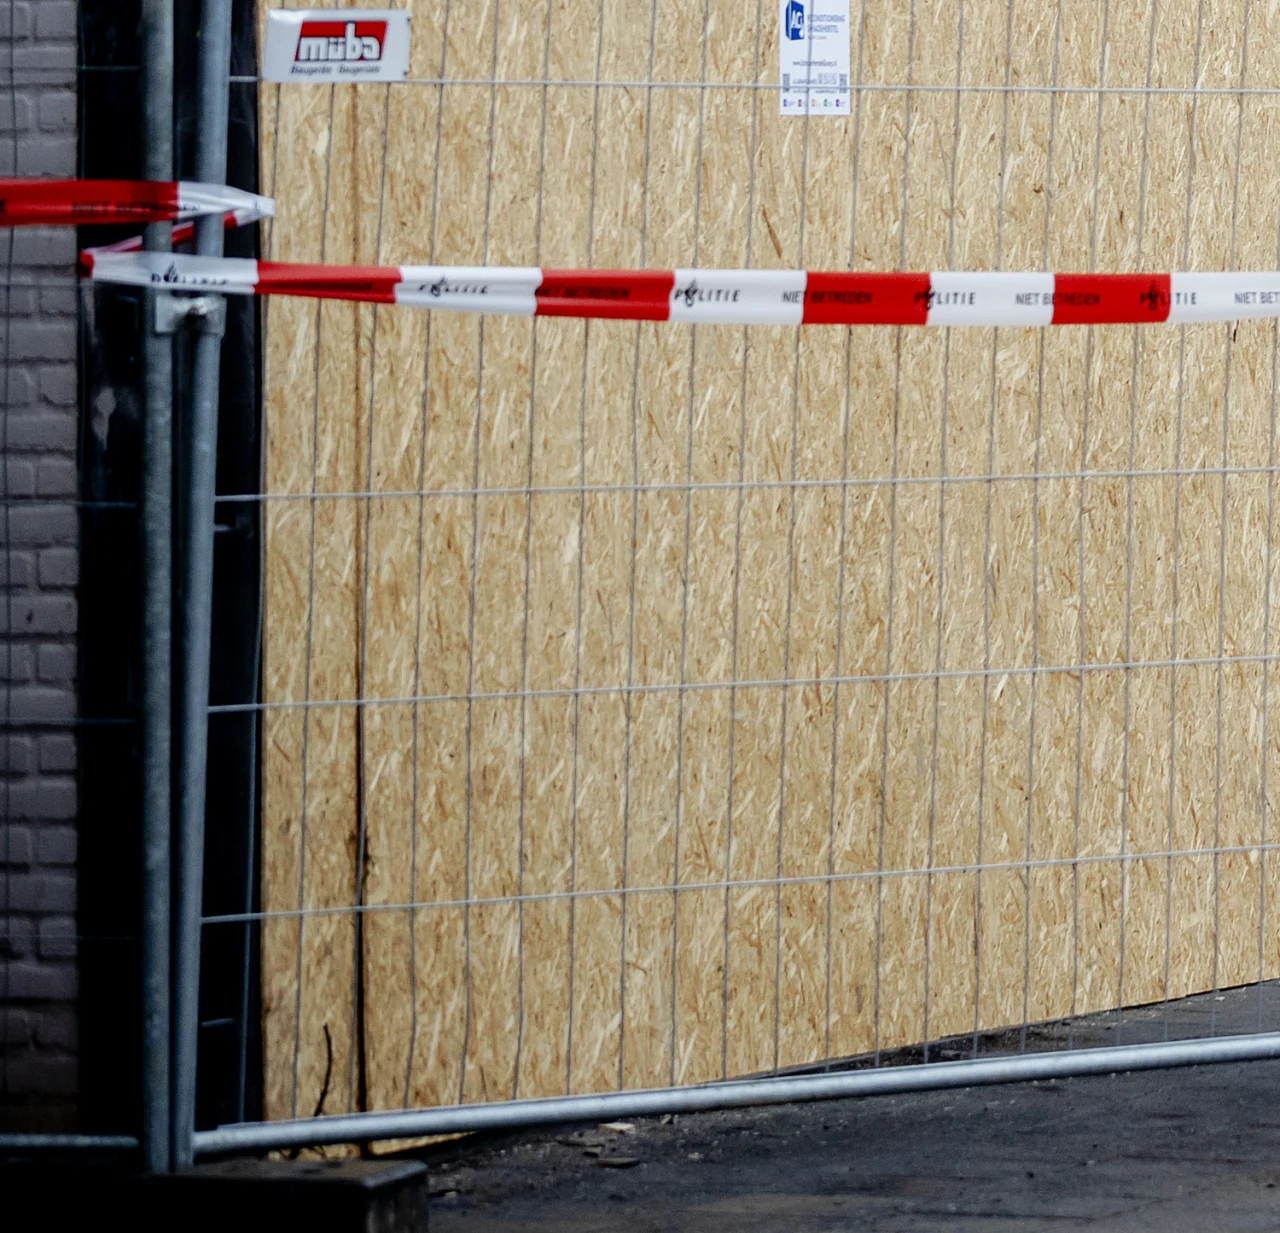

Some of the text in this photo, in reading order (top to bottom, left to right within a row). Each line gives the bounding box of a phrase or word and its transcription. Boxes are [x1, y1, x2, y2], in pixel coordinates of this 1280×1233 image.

[298, 22, 381, 61] müba
[1014, 292, 1041, 306] NIET
[1233, 291, 1258, 305] NIET
